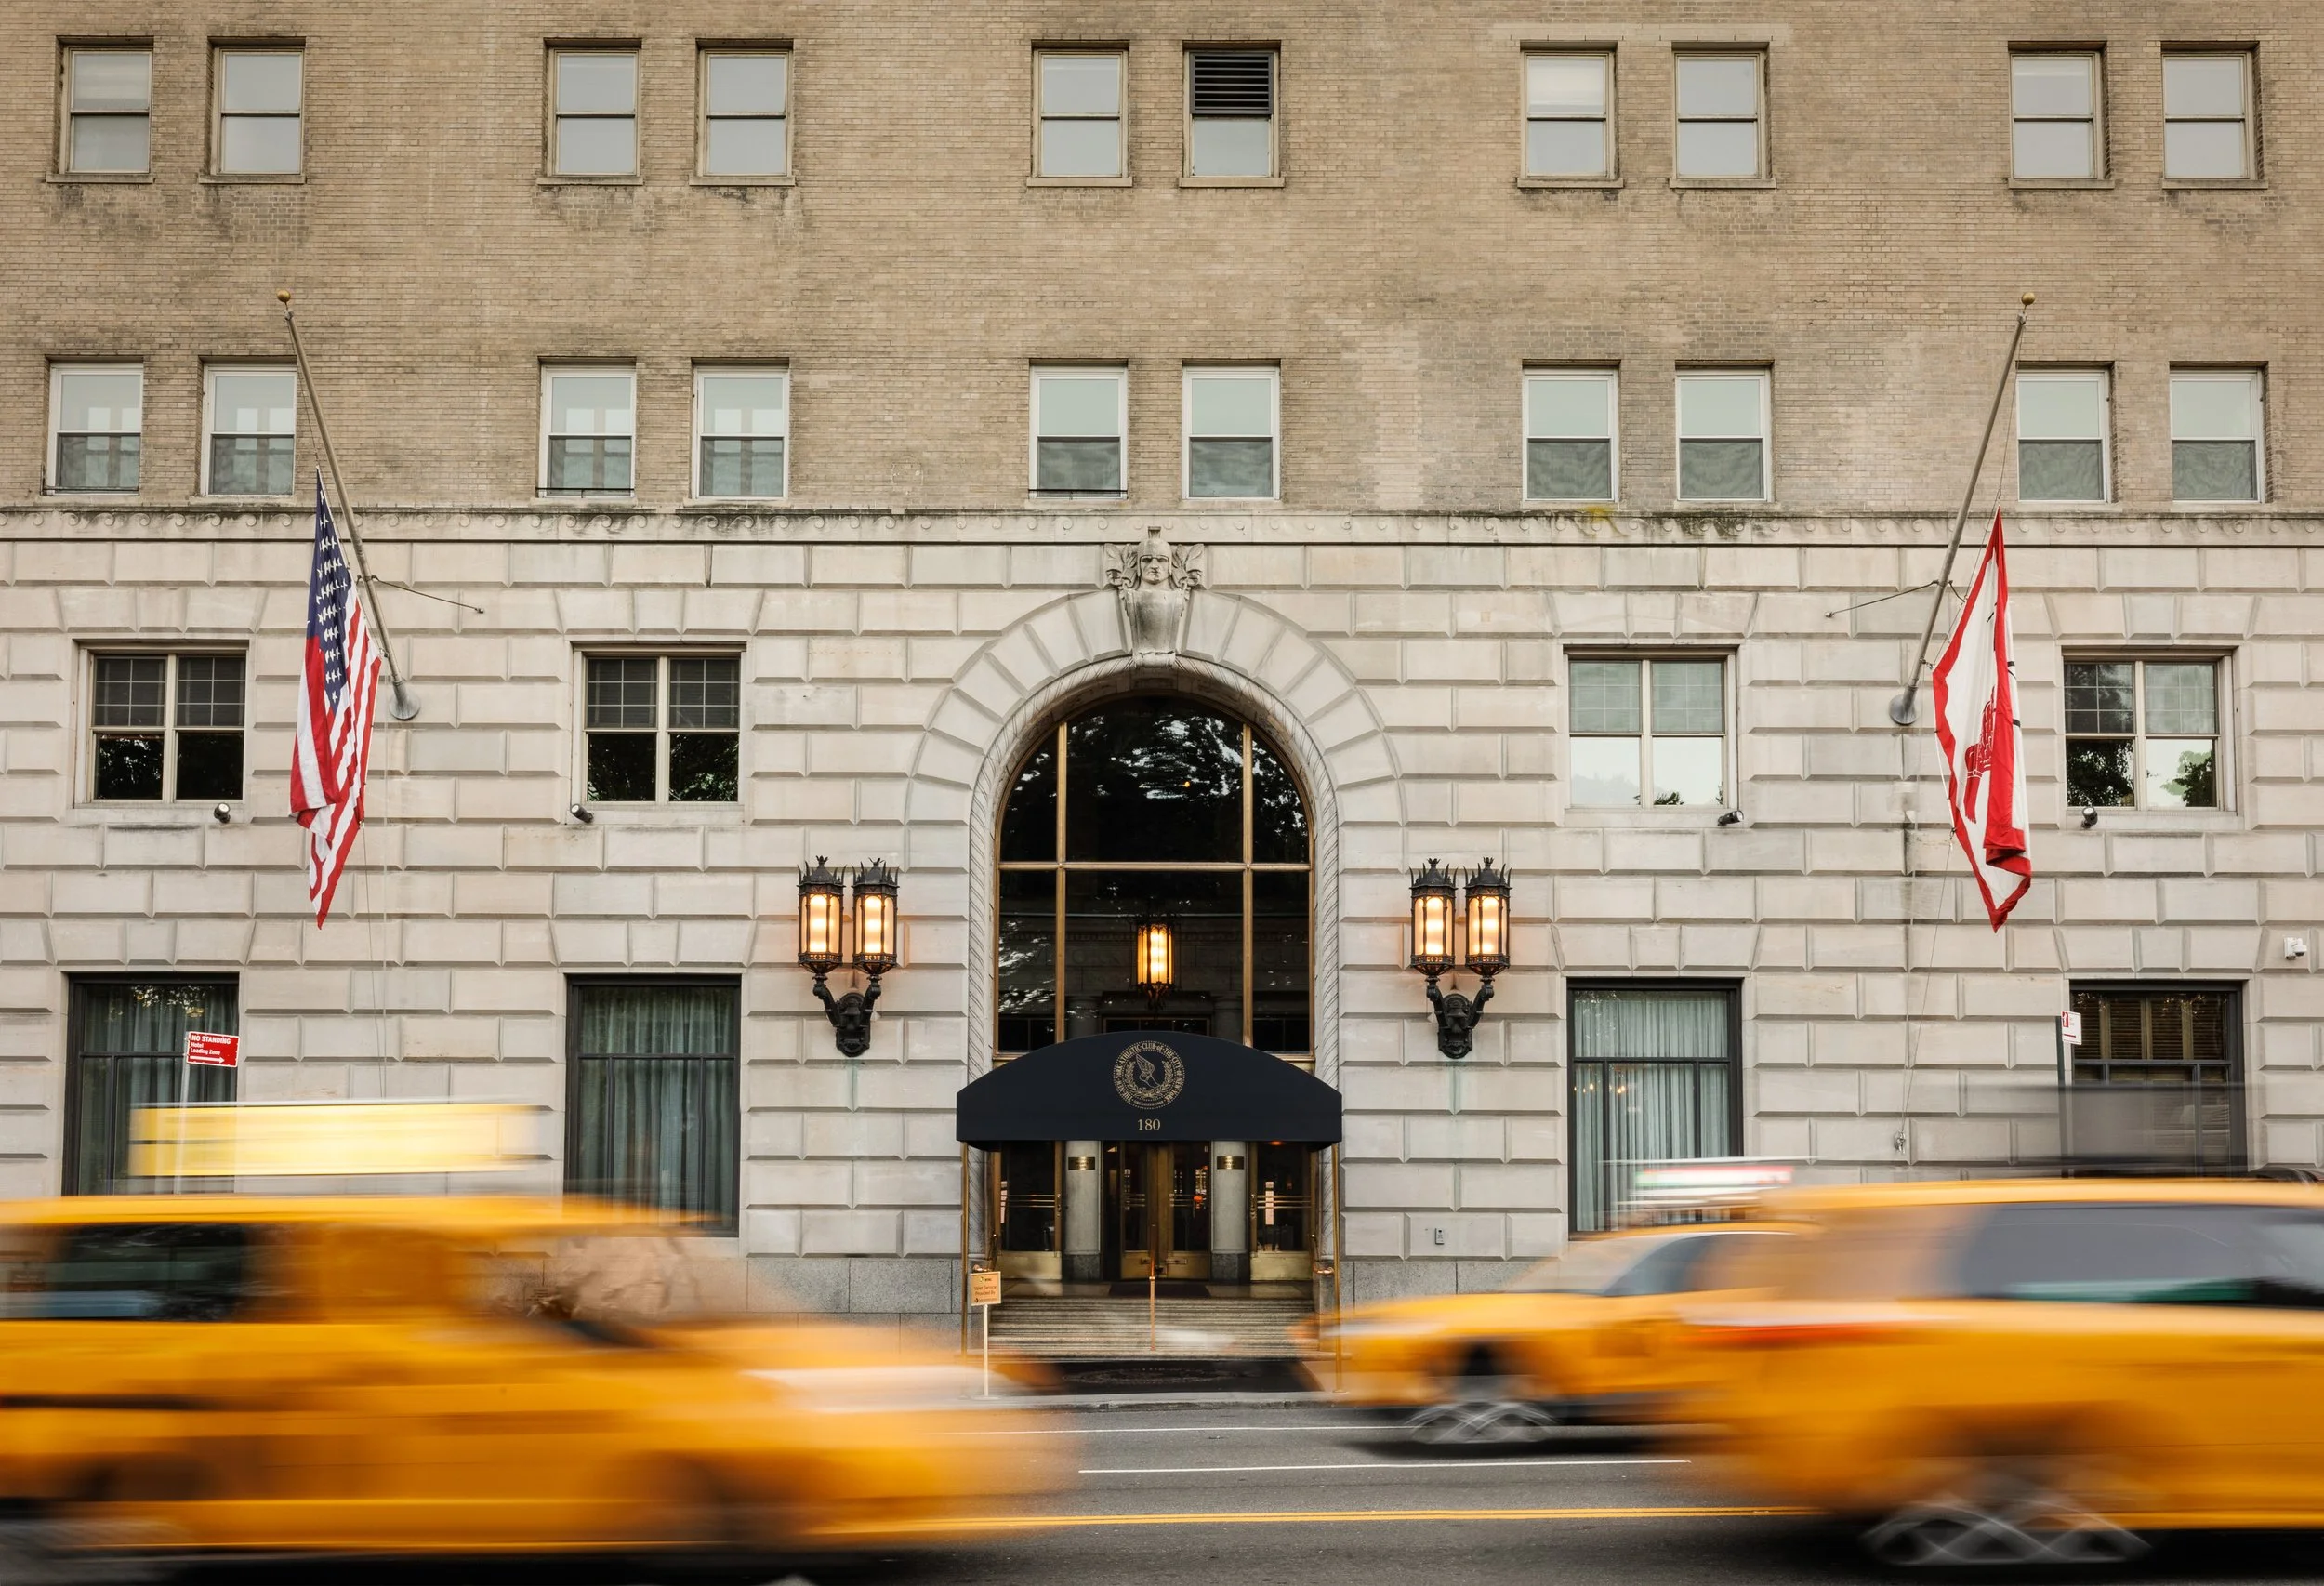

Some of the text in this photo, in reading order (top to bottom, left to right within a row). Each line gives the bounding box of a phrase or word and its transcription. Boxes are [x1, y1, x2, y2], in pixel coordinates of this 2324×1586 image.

[202, 1036, 231, 1044] STANDING
[1119, 1043, 1142, 1064] ATHLETIC
[1137, 1118, 1161, 1131] 180
